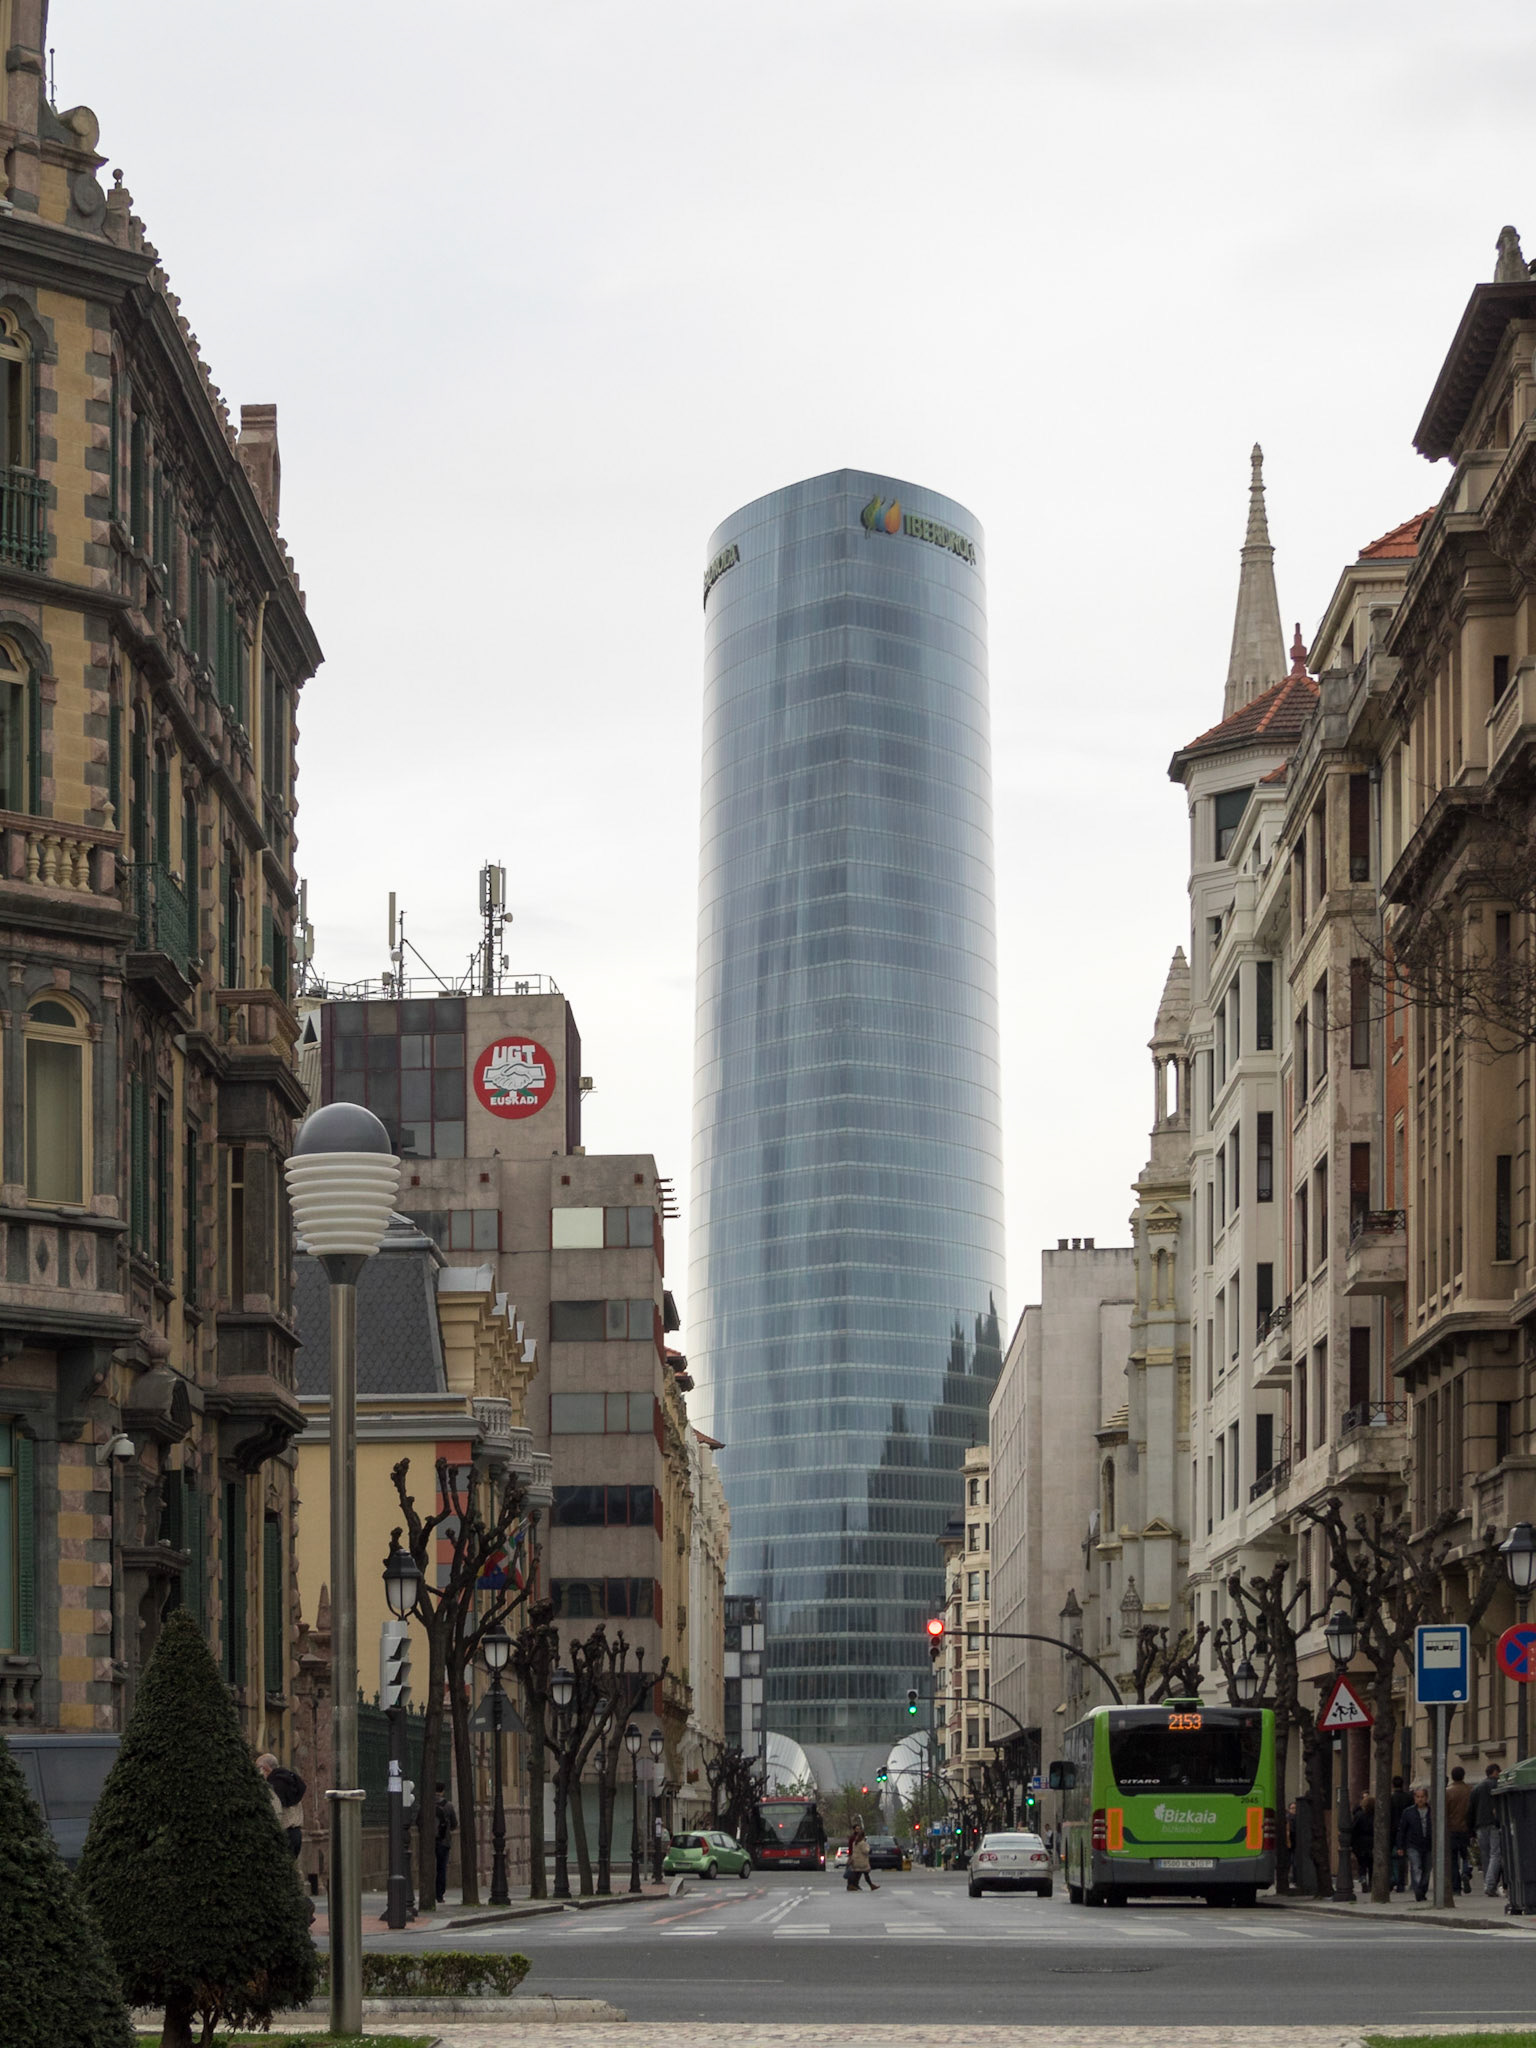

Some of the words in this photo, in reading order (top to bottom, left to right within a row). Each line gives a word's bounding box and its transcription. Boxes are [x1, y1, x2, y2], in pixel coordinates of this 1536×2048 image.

[903, 514, 977, 566] IBERDROLA
[492, 1045, 536, 1066] UGT
[490, 1095, 539, 1106] EUSKADI
[1168, 1713, 1202, 1730] 2153
[1164, 1809, 1217, 1824] Bizkaia
